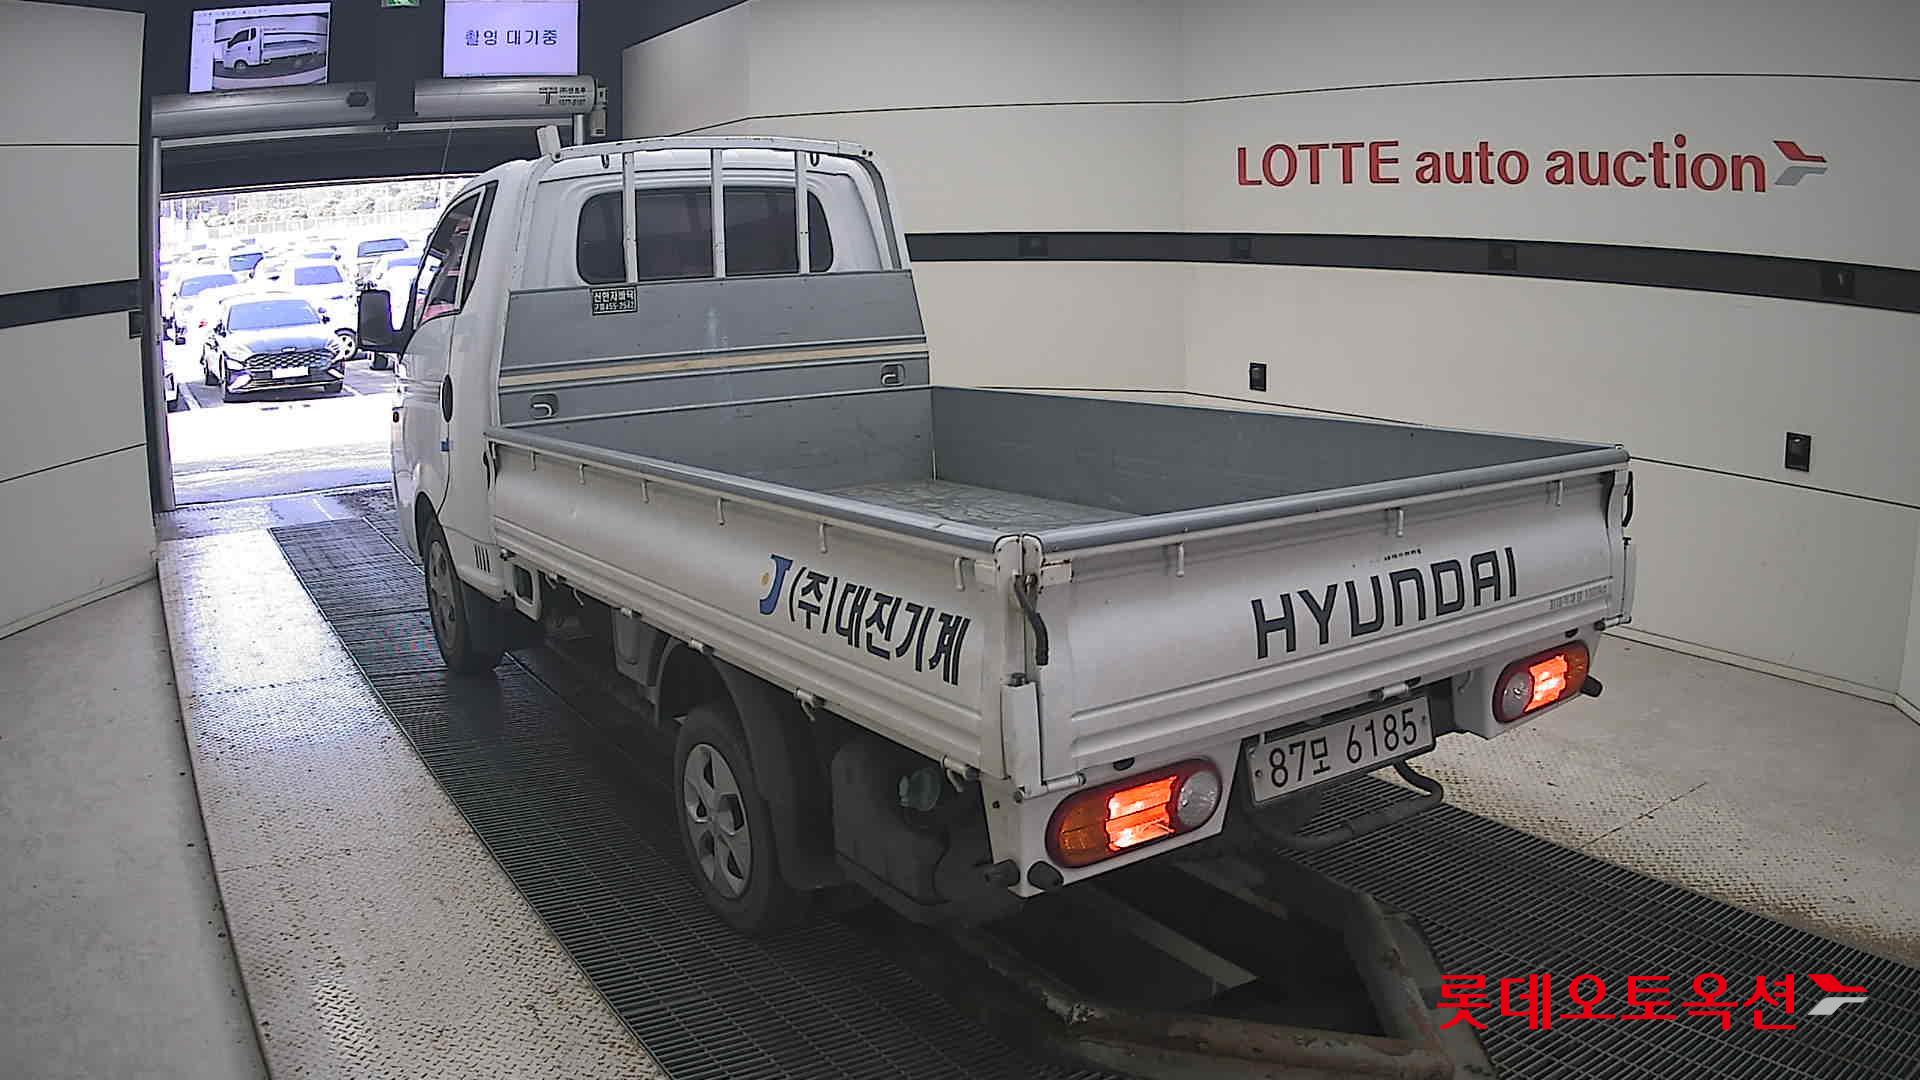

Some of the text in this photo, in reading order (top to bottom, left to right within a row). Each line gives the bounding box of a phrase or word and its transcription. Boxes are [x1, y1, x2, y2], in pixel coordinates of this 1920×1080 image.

[506, 29, 558, 46] 대기중
[1237, 133, 1767, 193] LOTTE auto auction
[788, 566, 971, 686] (주)대진기계
[1251, 547, 1517, 659] HYUNDAI
[1268, 707, 1418, 788] 87모 6185
